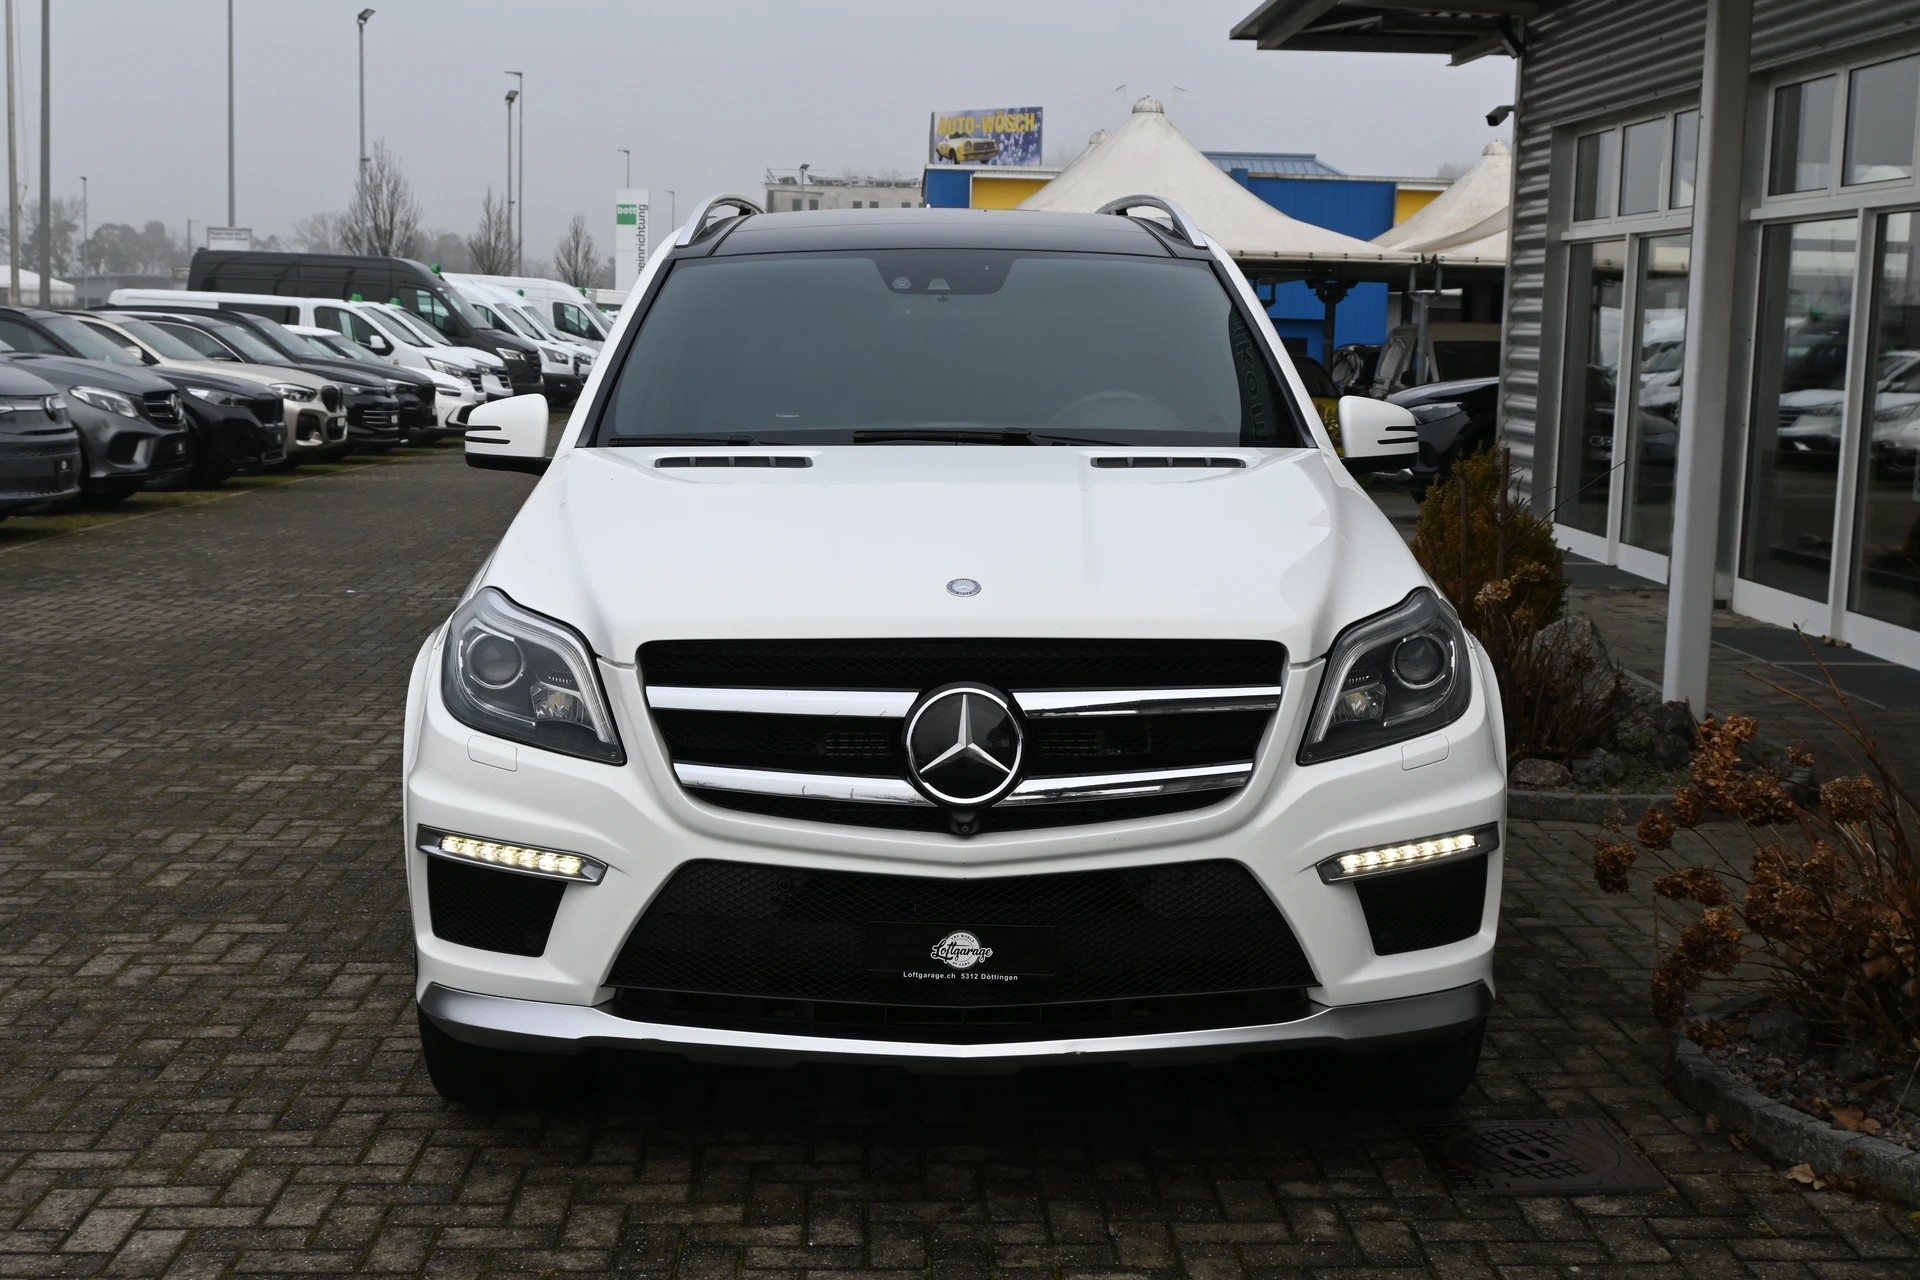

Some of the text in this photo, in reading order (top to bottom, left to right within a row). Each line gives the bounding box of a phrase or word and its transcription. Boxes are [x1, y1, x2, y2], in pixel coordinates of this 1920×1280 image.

[938, 111, 1035, 135] AUTO-WÖSCH
[617, 206, 636, 214] bott
[931, 939, 993, 963] Loftgarage
[903, 971, 1018, 981] Loftgarage.ch 5312 Döttingen
